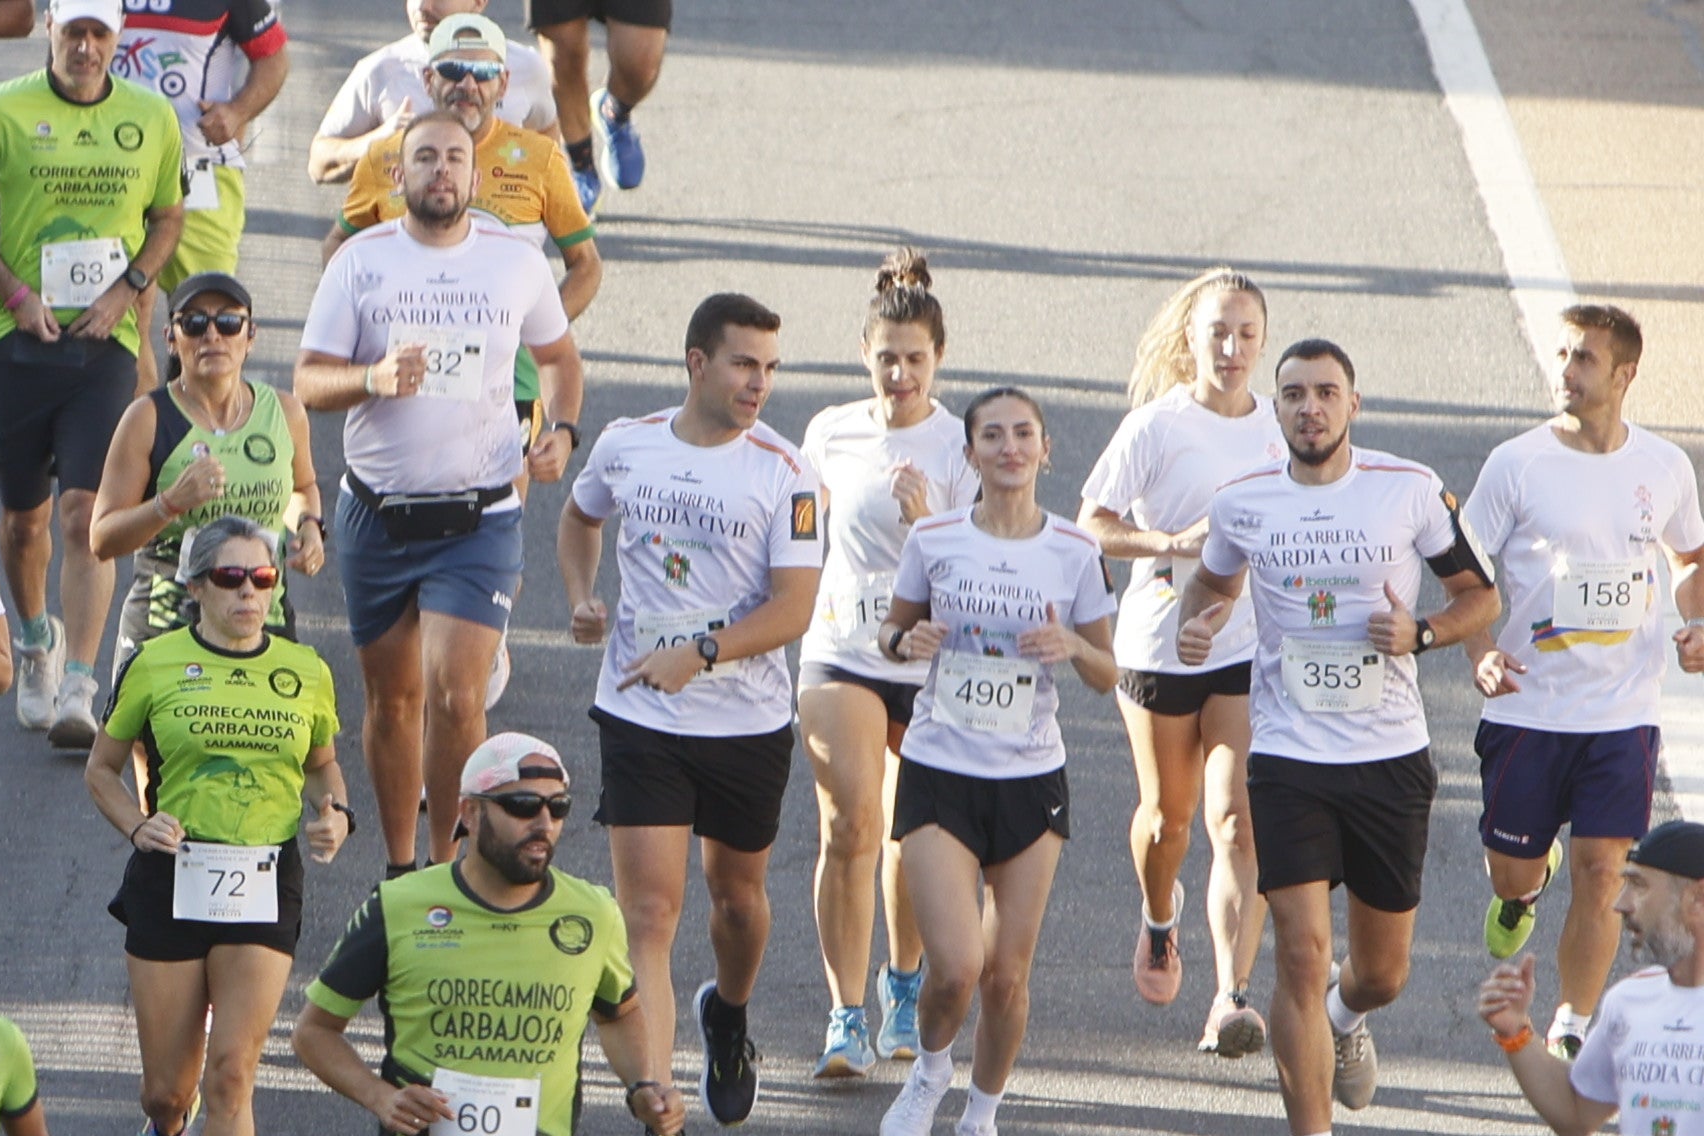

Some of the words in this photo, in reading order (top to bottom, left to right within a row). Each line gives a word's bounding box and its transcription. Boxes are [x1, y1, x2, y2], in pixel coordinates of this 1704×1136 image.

[30, 165, 141, 180] CORRECAMINOS
[44, 181, 128, 195] CARBAJOSA
[55, 196, 115, 208] SALAMANCA
[69, 262, 104, 285] 63
[398, 291, 414, 303] III
[429, 290, 489, 305] CARRERA
[464, 309, 511, 326] CIVIL
[637, 485, 652, 499] III
[658, 488, 725, 513] CARRERA
[699, 514, 748, 538] CIVIL
[1271, 531, 1285, 546] III
[1292, 529, 1367, 545] CARRERA
[1340, 544, 1394, 563] CIVIL
[959, 579, 973, 592] III
[978, 582, 1043, 601] CARRERA
[1577, 581, 1631, 608] 158
[1303, 662, 1362, 690] 353
[954, 678, 1014, 709] 490
[174, 705, 308, 727] CORRECAMINOS
[189, 721, 295, 740] CARBAJOSA
[204, 740, 279, 753] SALAMANCA
[208, 869, 245, 897] 72
[427, 978, 575, 1012] CORRECAMINOS
[430, 1012, 563, 1044] CARBAJOSA
[434, 1042, 555, 1064] SALAMANCA
[458, 1103, 501, 1134] 60
